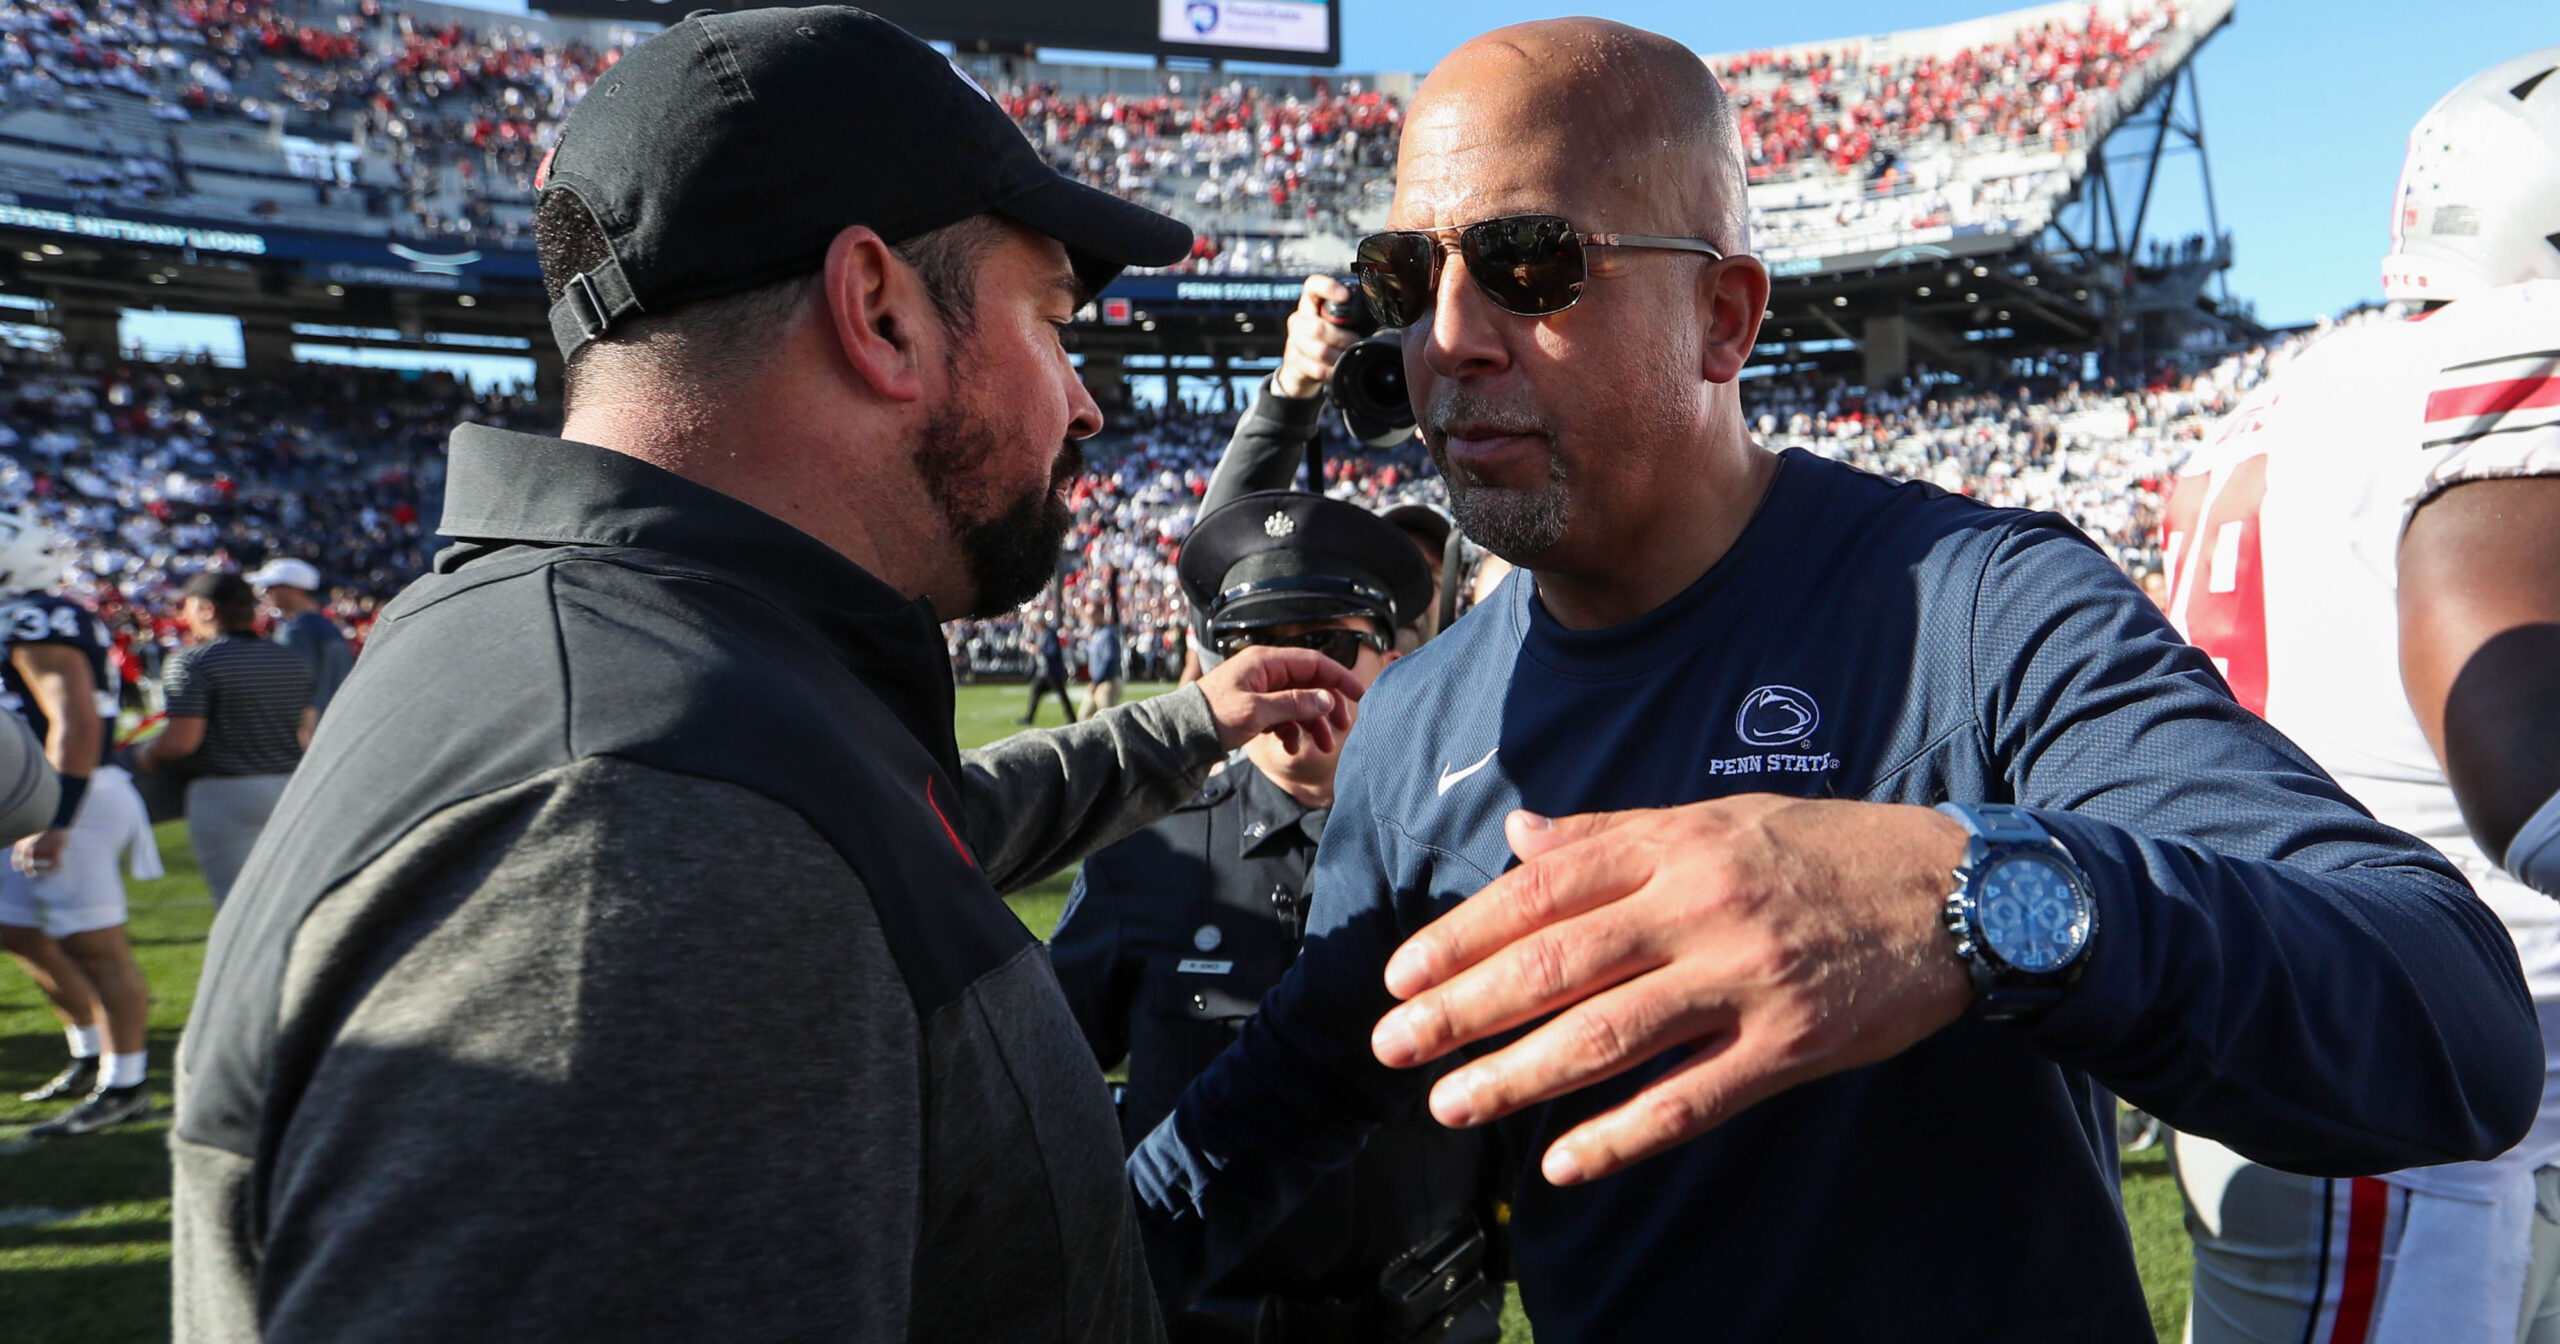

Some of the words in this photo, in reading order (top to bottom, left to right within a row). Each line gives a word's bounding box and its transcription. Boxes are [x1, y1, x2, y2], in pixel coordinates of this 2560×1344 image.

[76, 215, 188, 246] NITTANY
[187, 228, 266, 255] LIONS
[1177, 282, 1221, 299] PENN
[1224, 282, 1271, 299] STATE
[13, 606, 81, 641] 34
[1709, 754, 1763, 775] PENN
